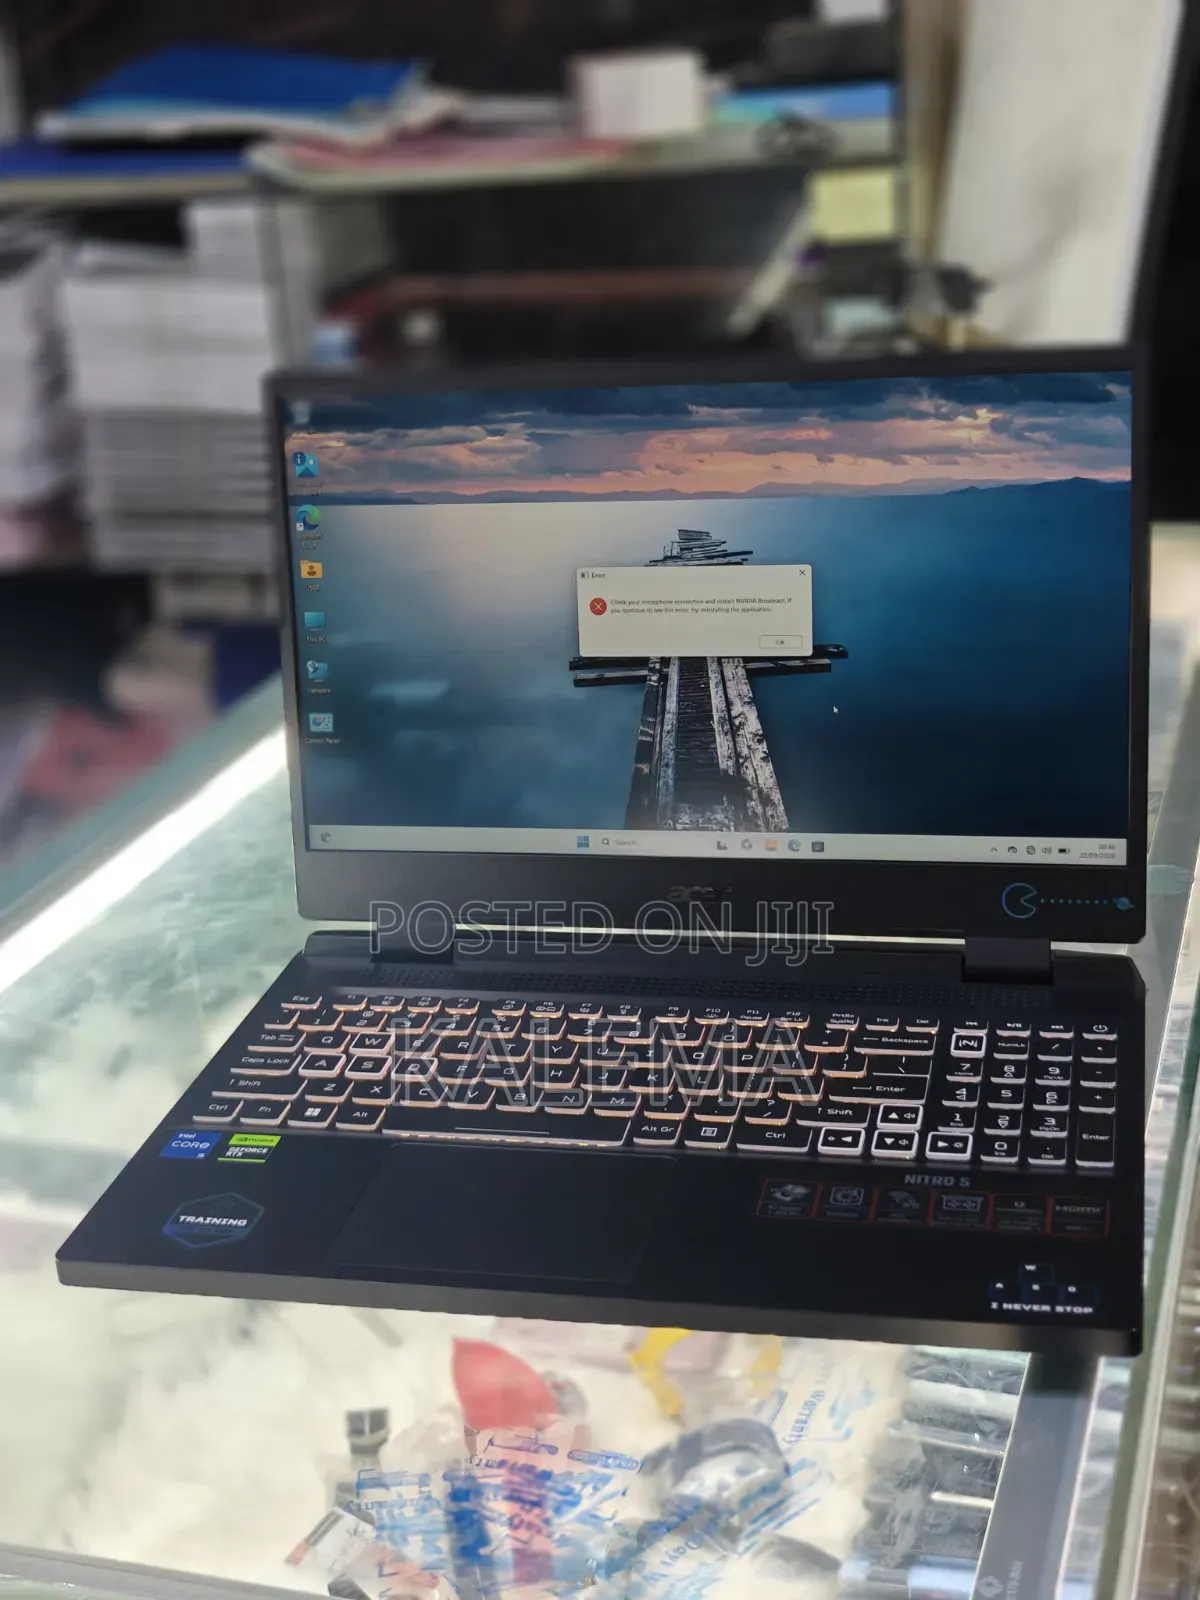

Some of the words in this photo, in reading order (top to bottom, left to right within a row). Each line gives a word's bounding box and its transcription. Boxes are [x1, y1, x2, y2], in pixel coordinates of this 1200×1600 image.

[641, 599, 673, 607] microphone
[614, 838, 637, 847] Search
[322, 1036, 334, 1044] Q
[364, 1037, 382, 1045] W
[413, 1039, 424, 1047] E
[457, 1041, 470, 1049] R
[506, 1043, 516, 1051] T
[597, 1047, 609, 1055] U
[241, 1056, 265, 1064] Caps
[267, 1056, 290, 1064] Lock
[361, 1061, 375, 1069] S
[407, 1063, 421, 1071] D
[323, 1083, 336, 1091] Z
[370, 1086, 383, 1094] X
[418, 1088, 430, 1096] C
[955, 1088, 967, 1096] 4
[562, 1095, 575, 1103] N
[827, 1108, 853, 1116] Shift
[954, 1113, 962, 1121] 1
[998, 1115, 1010, 1123] 2
[1044, 1117, 1056, 1125] 3
[229, 1146, 269, 1154] GEFORCE
[904, 1174, 955, 1186] NITRO
[179, 1215, 248, 1226] TRAINING
[1003, 1303, 1051, 1312] NEVER
[1055, 1306, 1093, 1314] STOP
[782, 1390, 825, 1445] Warranty
